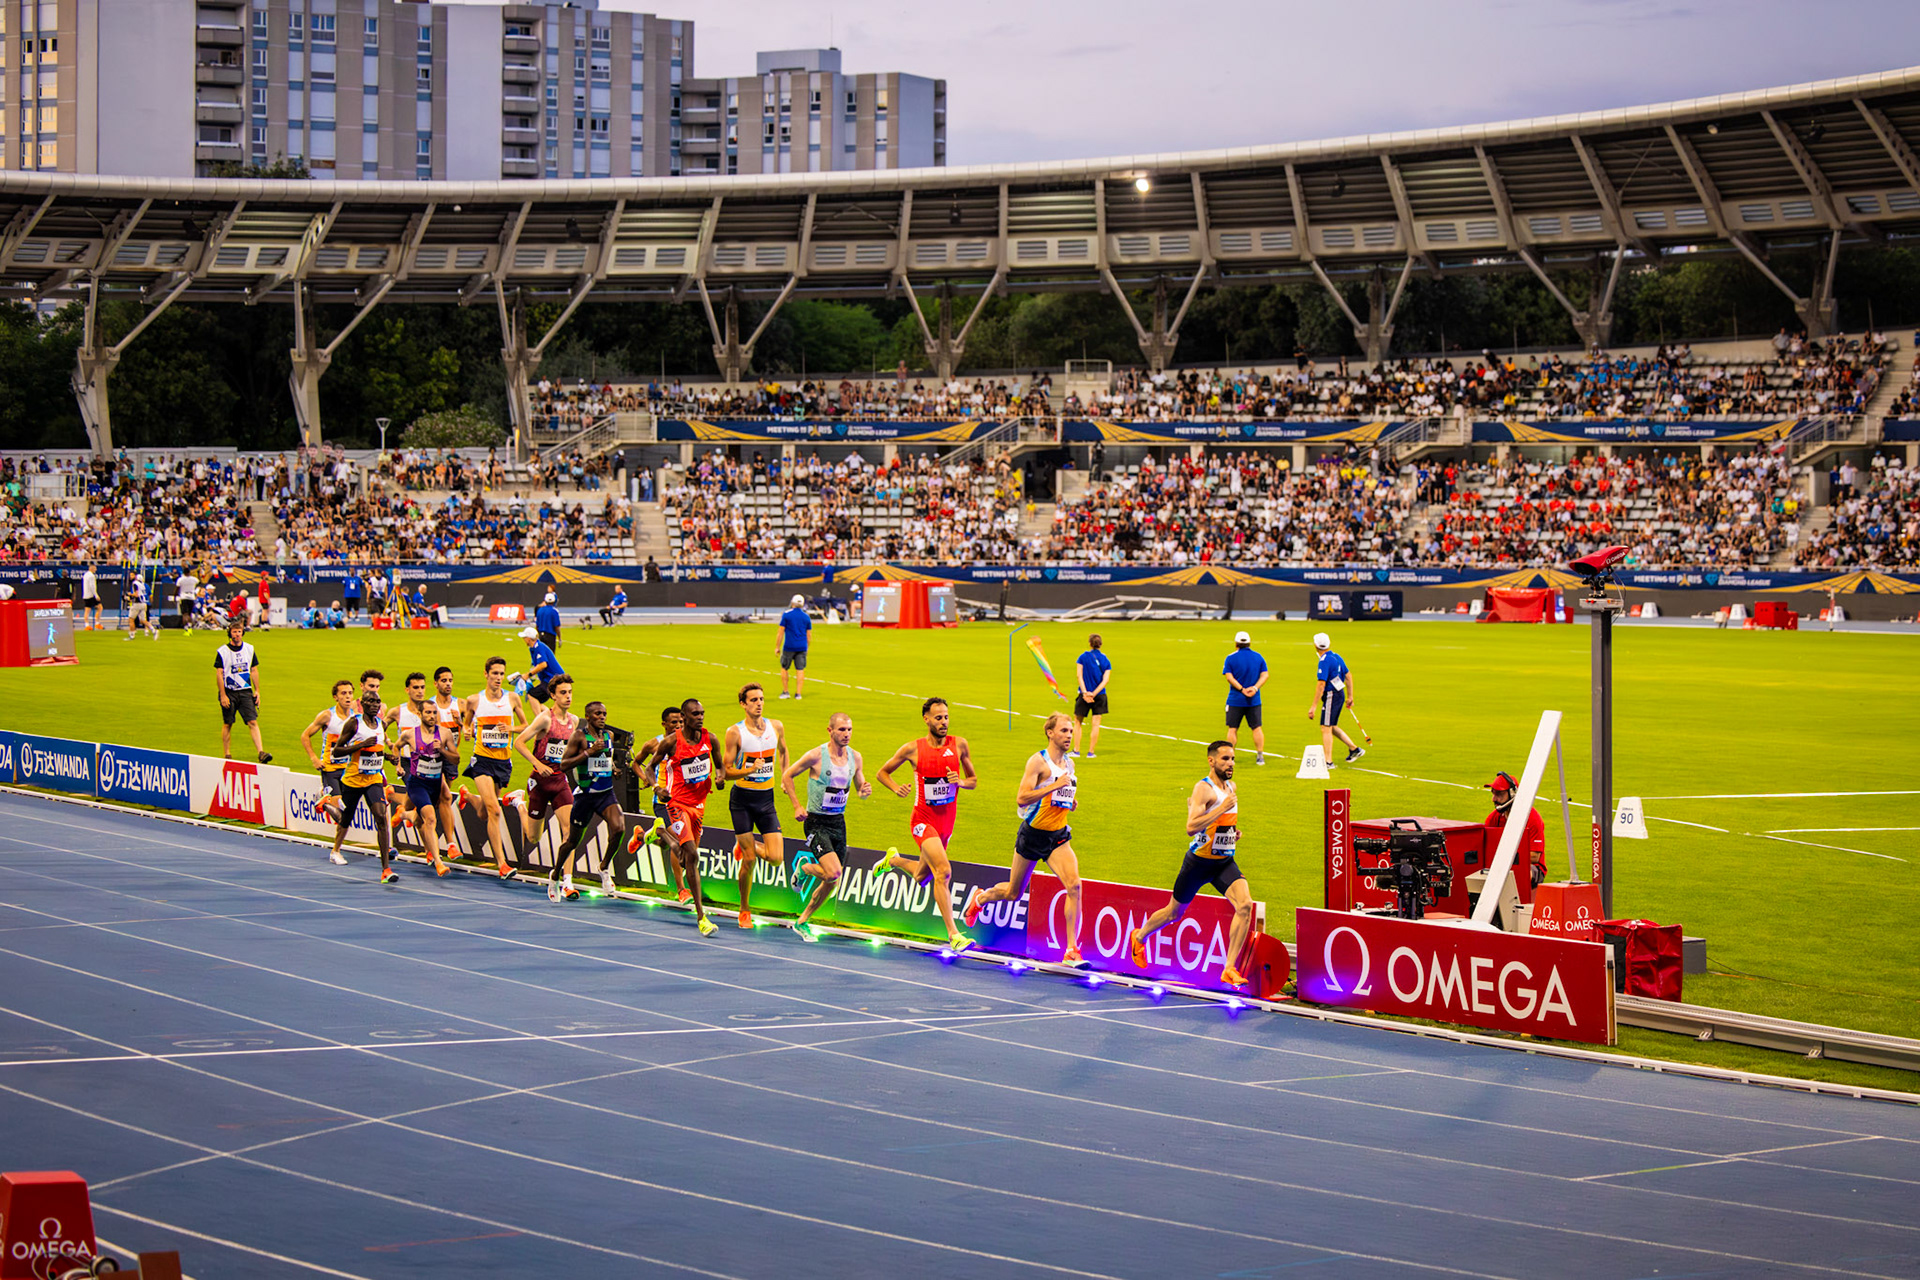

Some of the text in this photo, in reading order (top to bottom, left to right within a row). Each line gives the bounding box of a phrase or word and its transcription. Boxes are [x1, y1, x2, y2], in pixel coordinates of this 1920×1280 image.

[767, 426, 799, 434] MEETING
[972, 570, 1006, 578] MEETING
[1304, 572, 1338, 580] MEETING
[1634, 574, 1667, 583] MEETING
[688, 763, 707, 774] KOECH
[1306, 758, 1317, 768] 80
[217, 770, 262, 814] MAIF
[932, 786, 950, 796] HABZ
[1620, 812, 1634, 825] 90
[1332, 819, 1343, 879] OMEGA
[831, 865, 931, 914] IAMOND
[1531, 918, 1561, 932] OMEGA
[1387, 945, 1577, 1026] OMEGA
[12, 1240, 91, 1260] OMEGA
